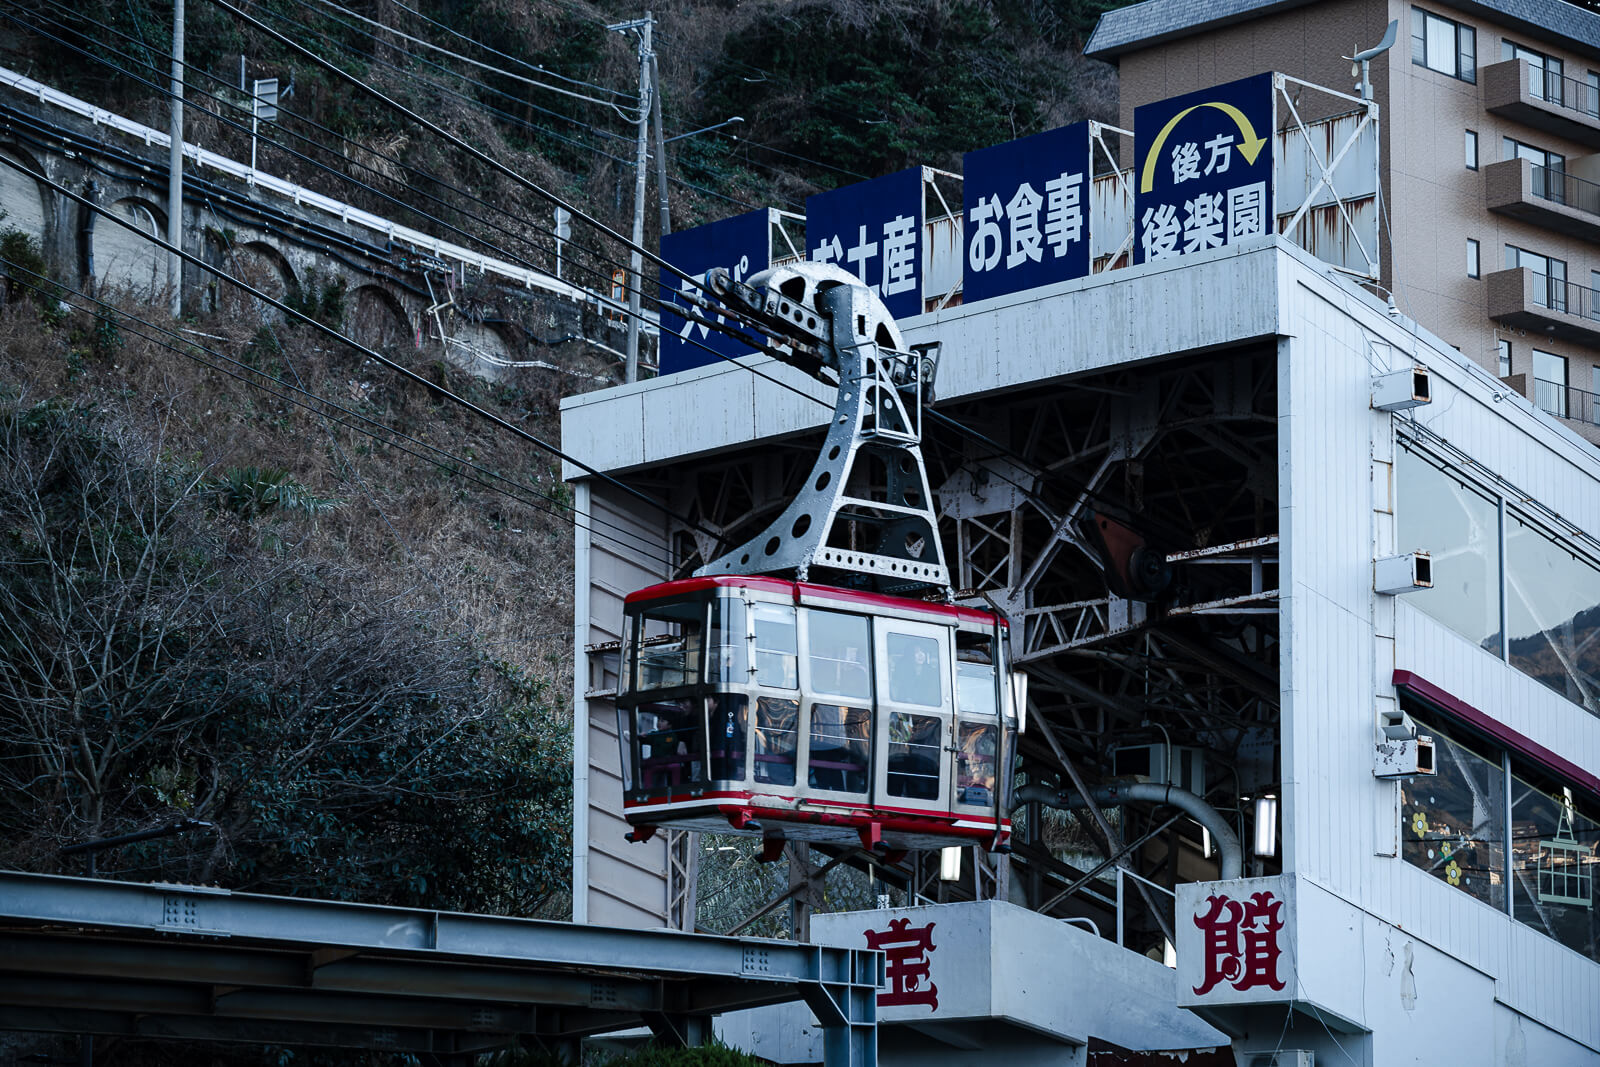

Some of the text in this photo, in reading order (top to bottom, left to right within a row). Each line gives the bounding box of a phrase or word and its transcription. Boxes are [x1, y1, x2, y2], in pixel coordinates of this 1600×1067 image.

[1171, 133, 1234, 185] 後方
[969, 171, 1083, 272] お食事
[1141, 180, 1266, 262] 後楽園
[863, 917, 939, 1013] 宝
[1192, 890, 1287, 996] 館
